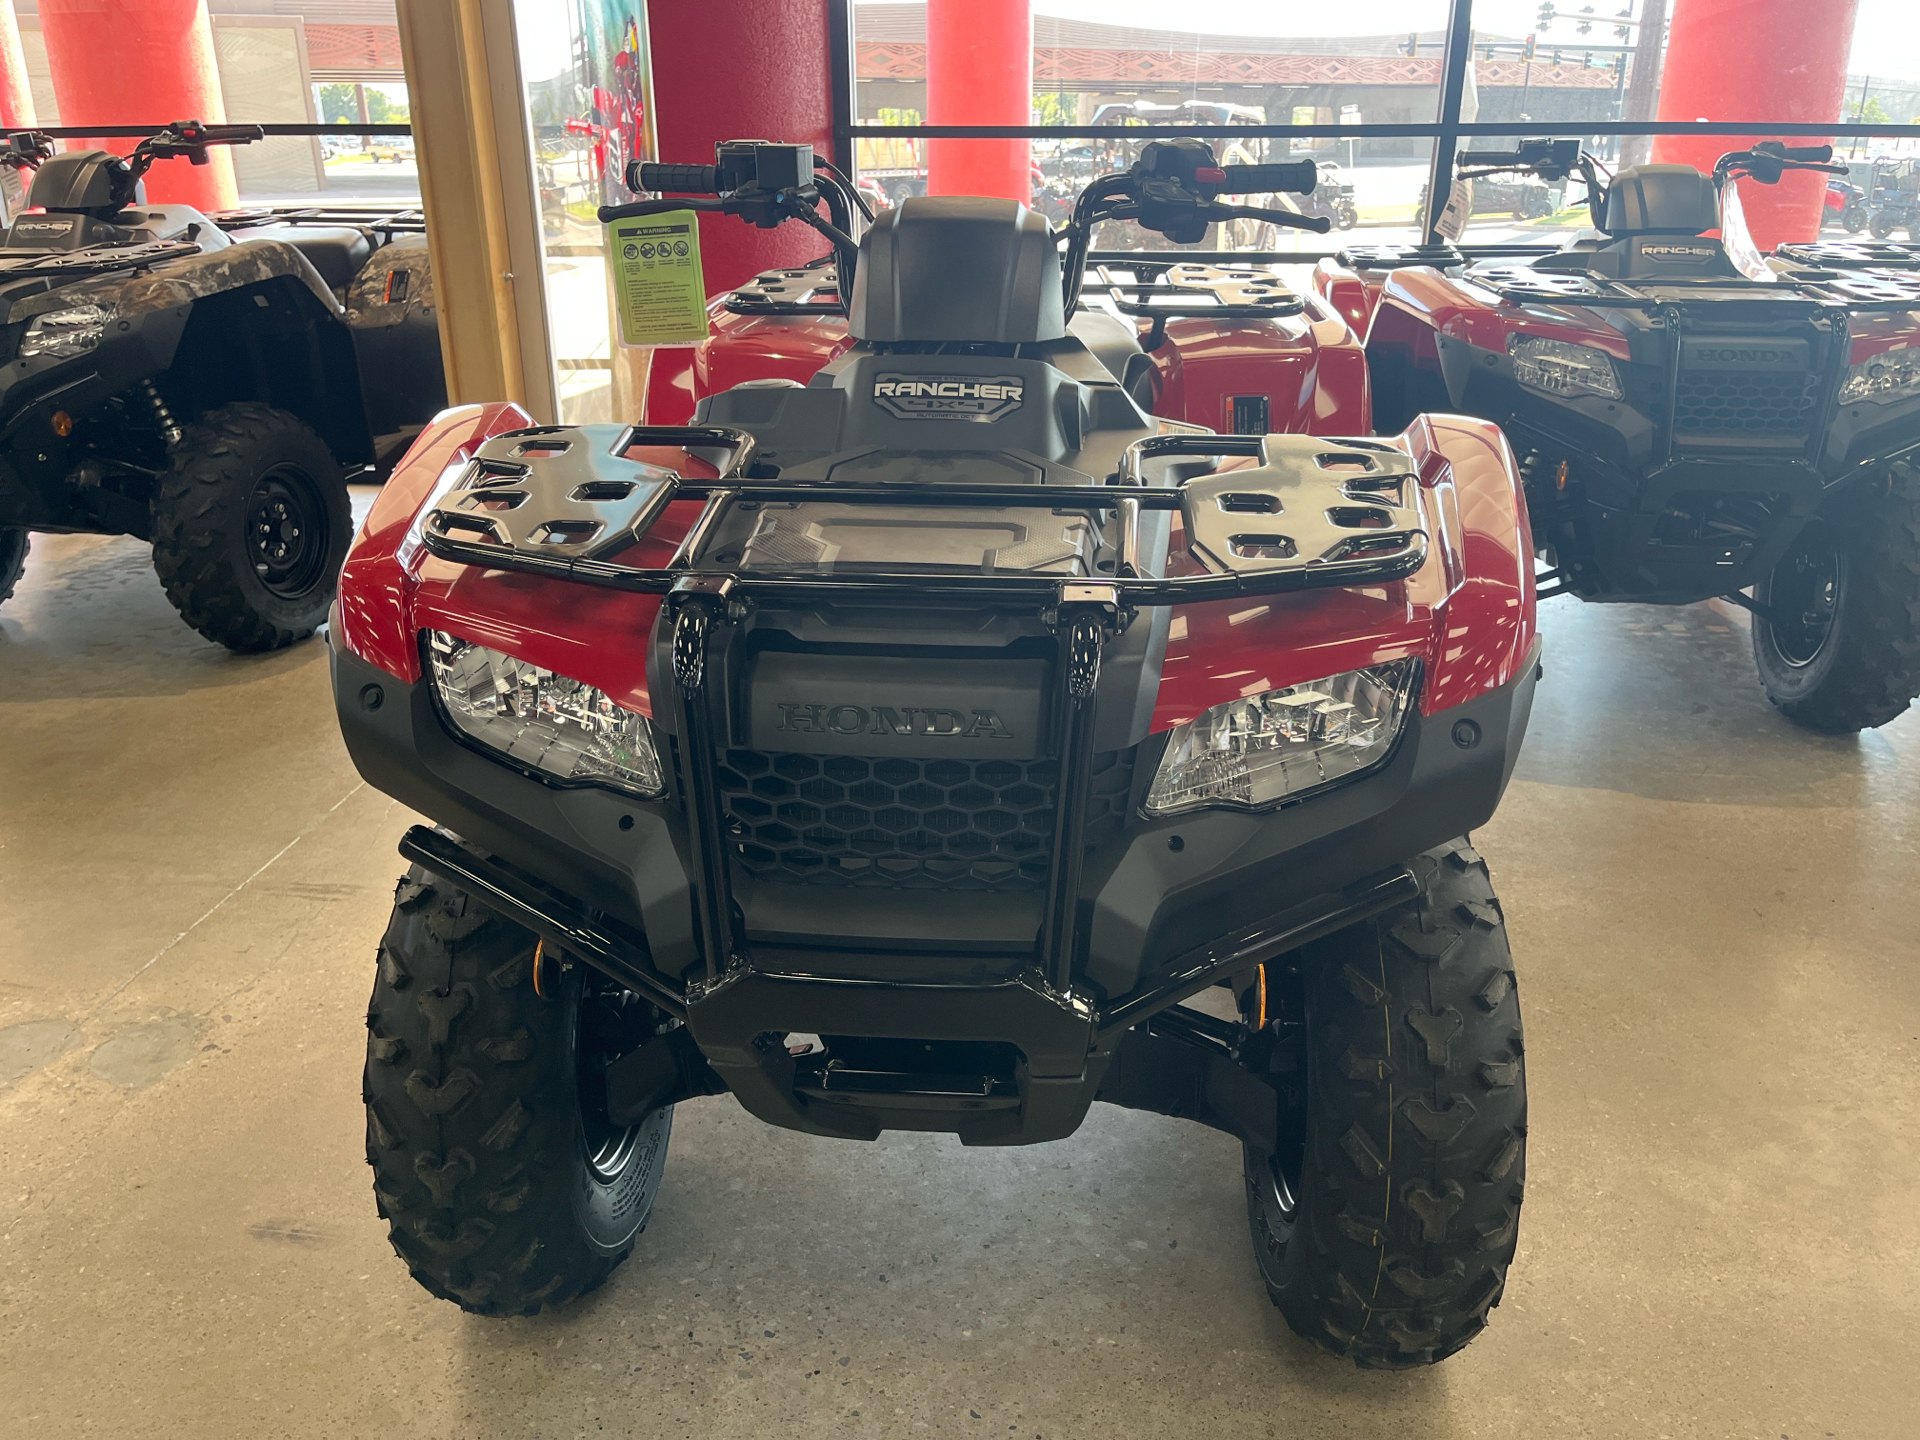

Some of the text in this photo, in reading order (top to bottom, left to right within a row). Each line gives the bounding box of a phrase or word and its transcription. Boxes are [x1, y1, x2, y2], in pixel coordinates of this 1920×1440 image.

[1641, 247, 1716, 256] RANCHER
[1698, 350, 1797, 362] HONDA
[874, 382, 1023, 401] RANCHER
[777, 703, 1014, 738] HONDA
